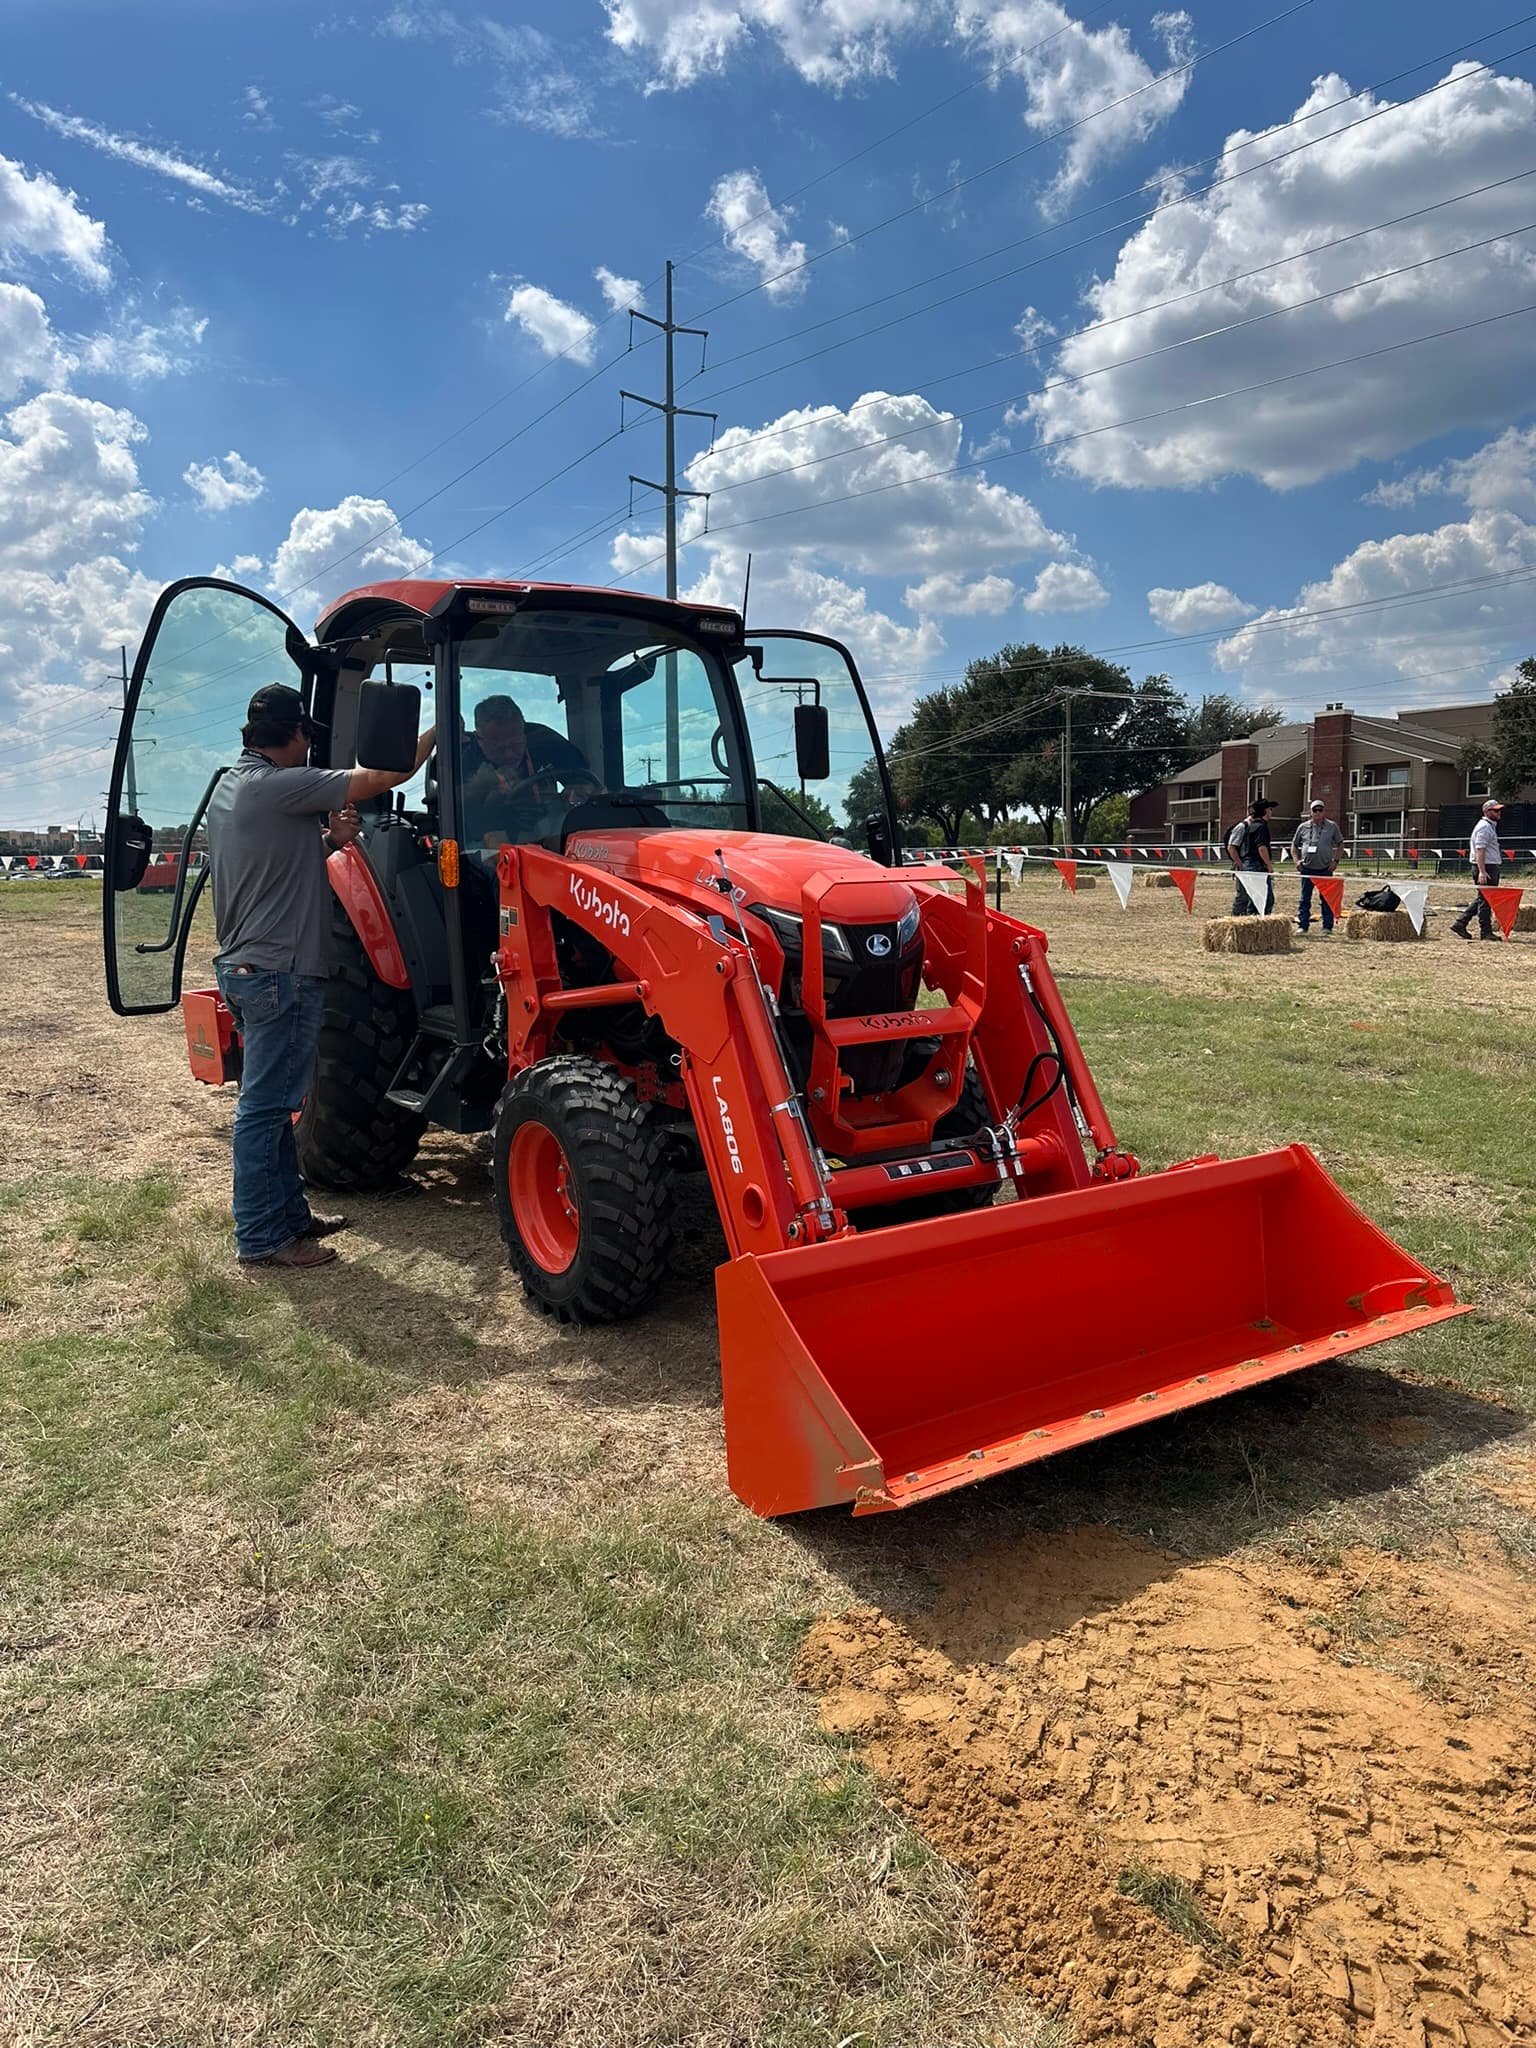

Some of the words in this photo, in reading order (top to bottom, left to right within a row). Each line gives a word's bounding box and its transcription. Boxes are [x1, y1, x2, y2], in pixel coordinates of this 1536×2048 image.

[575, 841, 609, 860] Kubota
[570, 873, 630, 937] Kubota
[859, 1013, 933, 1029] Kubota
[713, 1076, 744, 1174] LA806
